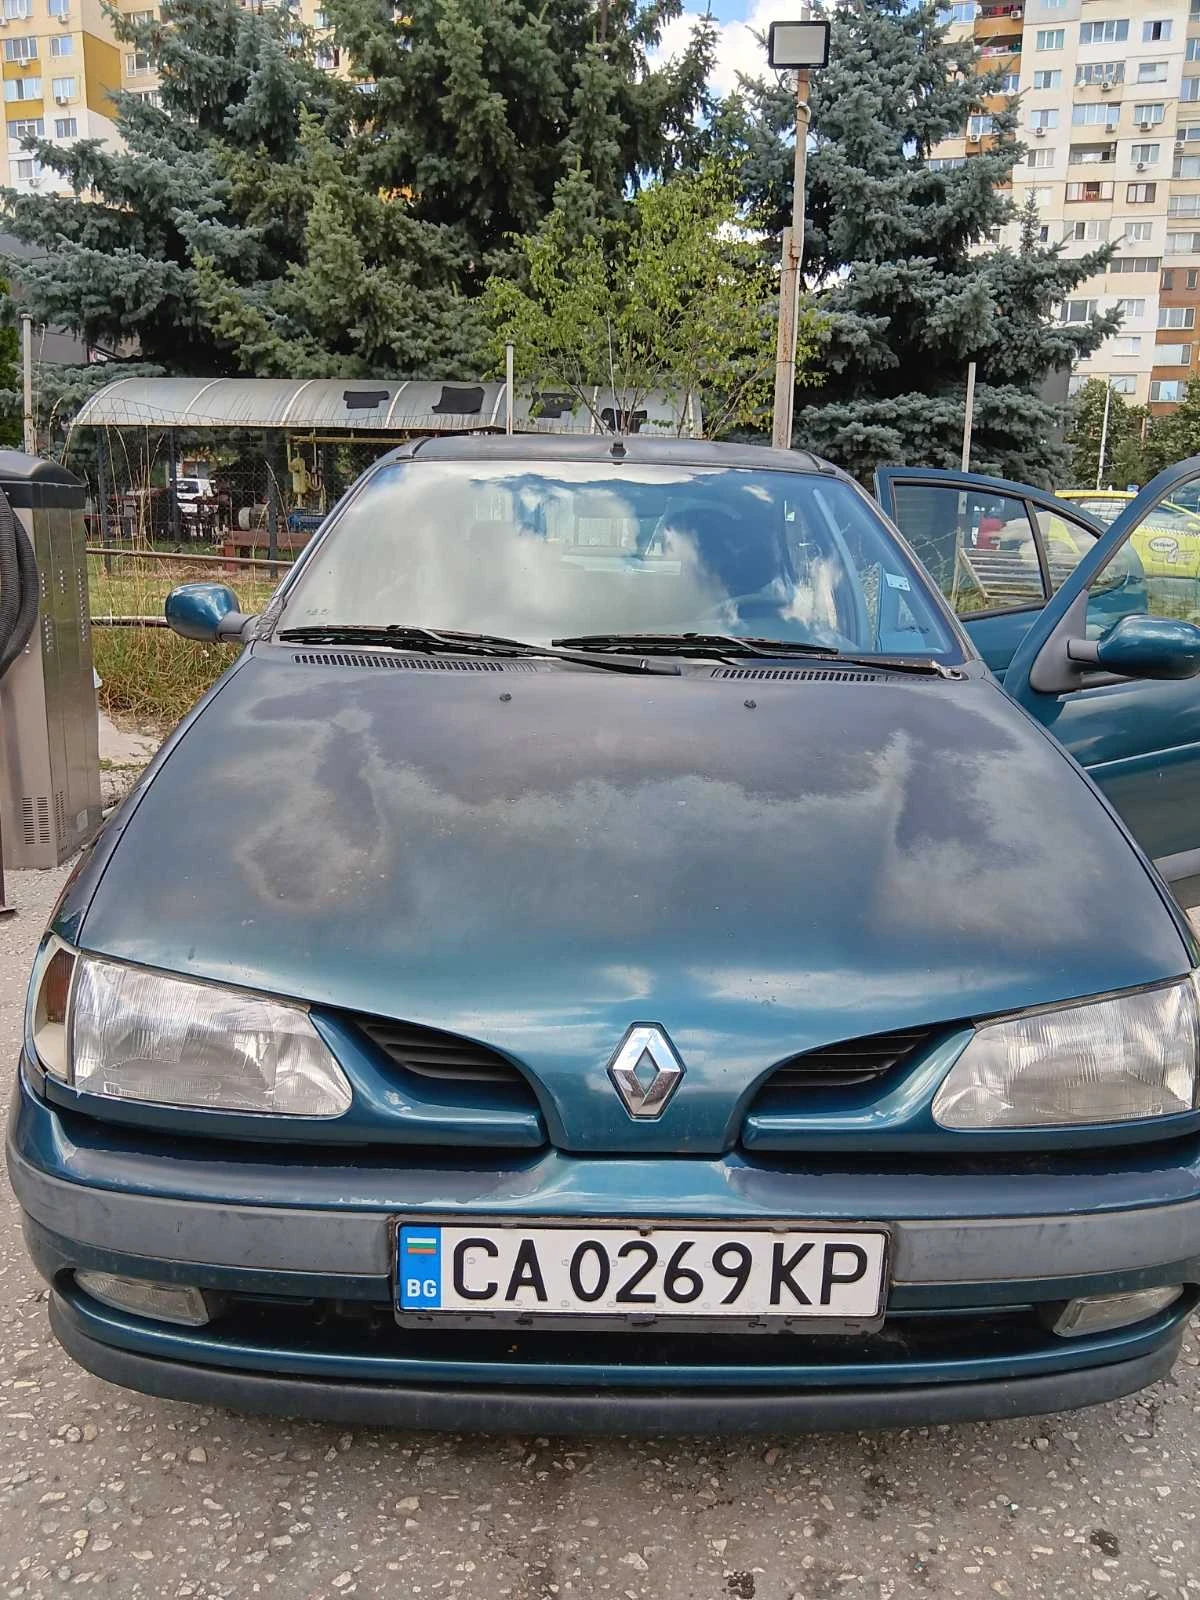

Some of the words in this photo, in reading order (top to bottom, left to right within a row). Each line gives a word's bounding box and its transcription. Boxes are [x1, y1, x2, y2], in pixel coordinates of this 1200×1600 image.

[406, 1279, 437, 1298] BG
[453, 1237, 548, 1302] CA
[569, 1240, 753, 1305] 0269
[769, 1242, 868, 1306] KP
